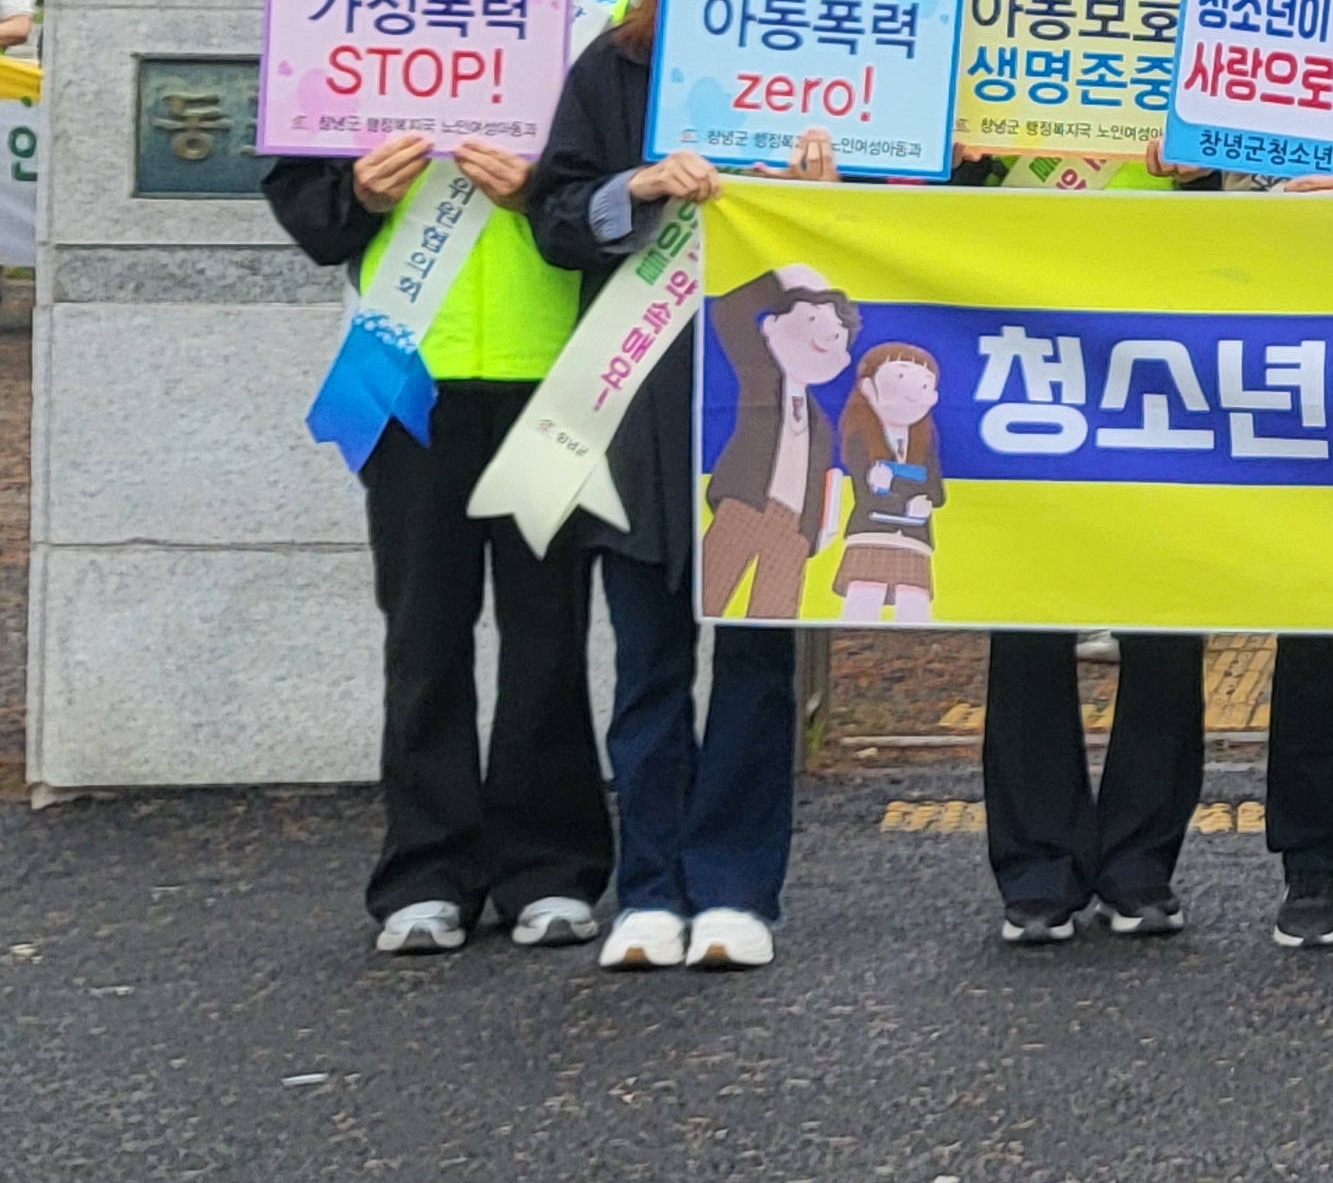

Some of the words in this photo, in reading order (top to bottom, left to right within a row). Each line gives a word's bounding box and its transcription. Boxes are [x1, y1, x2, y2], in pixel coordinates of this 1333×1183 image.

[326, 44, 503, 104] STOP!
[733, 65, 875, 122] zero!
[967, 46, 1173, 111] 생명존중
[707, 129, 748, 147] 창녕군
[753, 131, 806, 150] 행정복
[980, 117, 1020, 135] 창녕군
